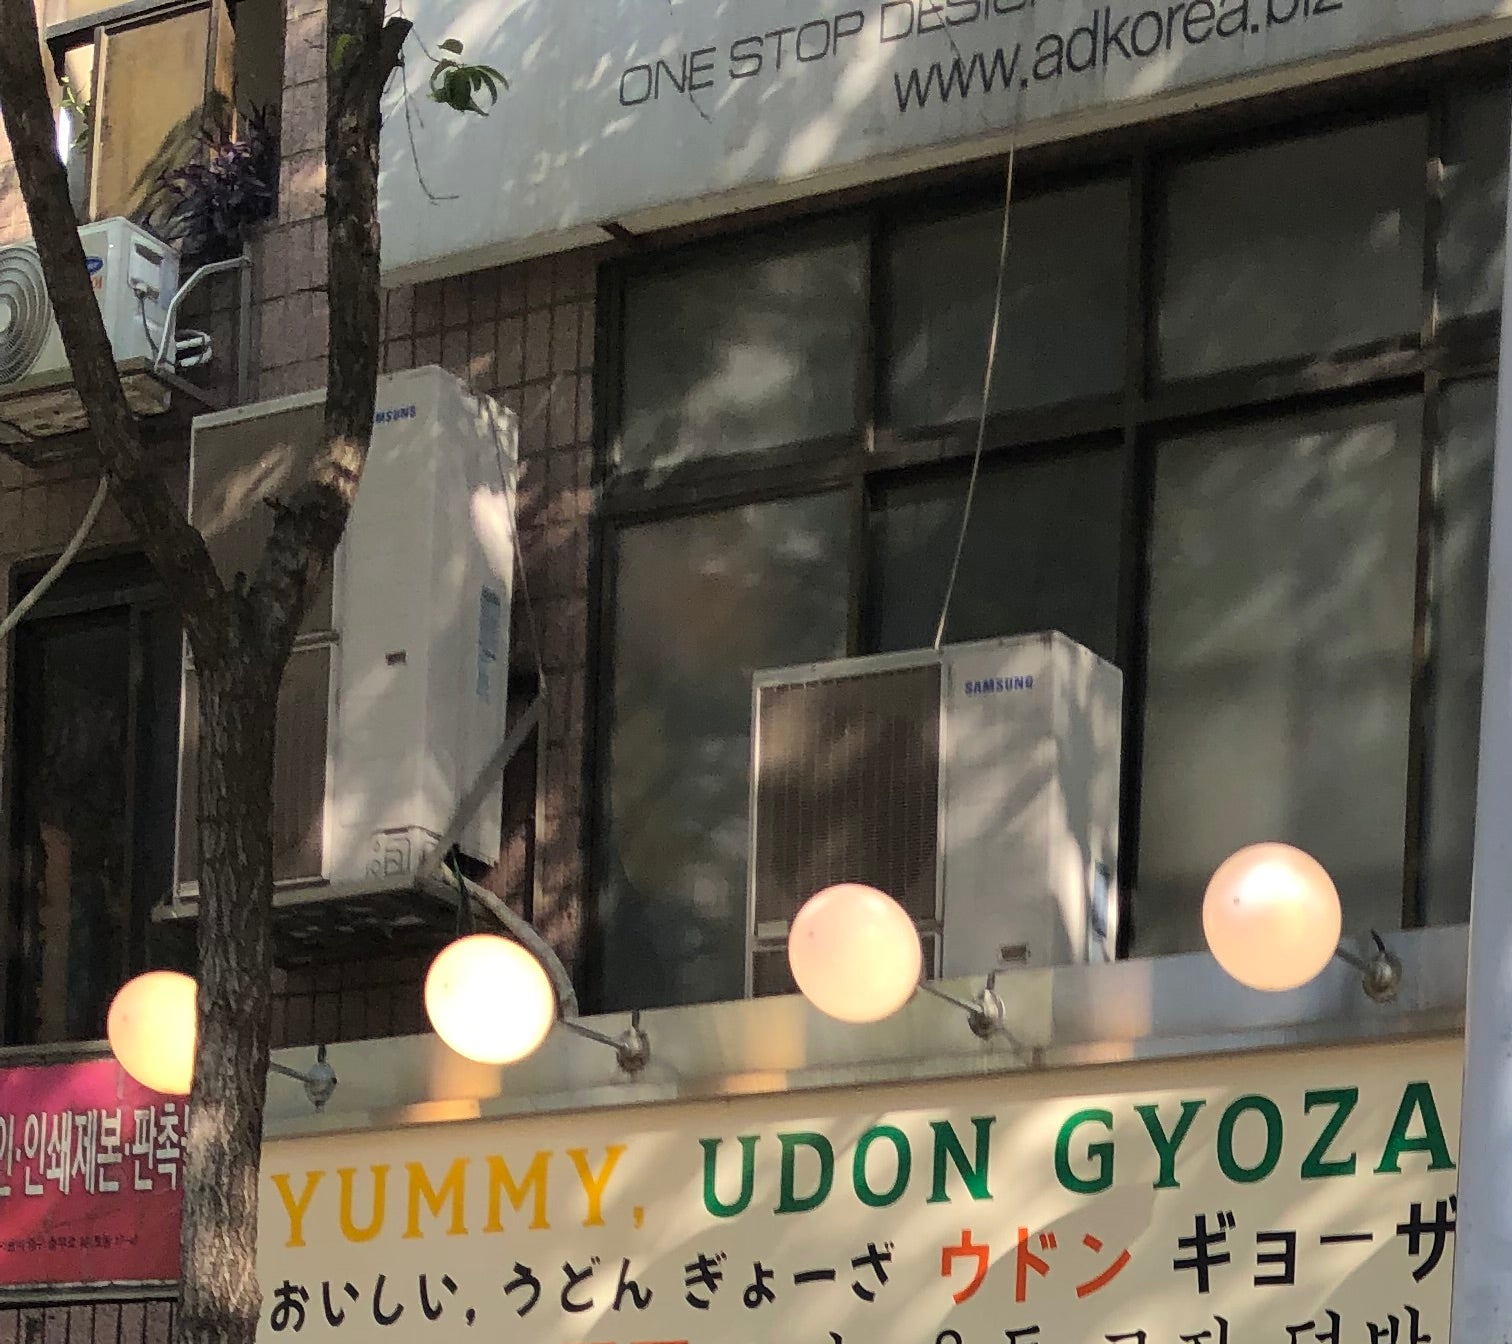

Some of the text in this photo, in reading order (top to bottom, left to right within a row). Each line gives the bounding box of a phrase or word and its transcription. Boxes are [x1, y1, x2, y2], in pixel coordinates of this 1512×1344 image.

[619, 47, 716, 106] ONE
[729, 11, 864, 80] STOP
[375, 405, 417, 423] MSUNG
[965, 675, 1033, 694] SAMSUNG
[269, 1080, 1457, 1248] YUMMY, UDON GYOZA
[503, 1254, 654, 1317] うどん
[683, 1240, 895, 1311] ぎょーざ
[940, 1225, 1132, 1305] ウドン
[1172, 1193, 1457, 1295] ギョーザ
